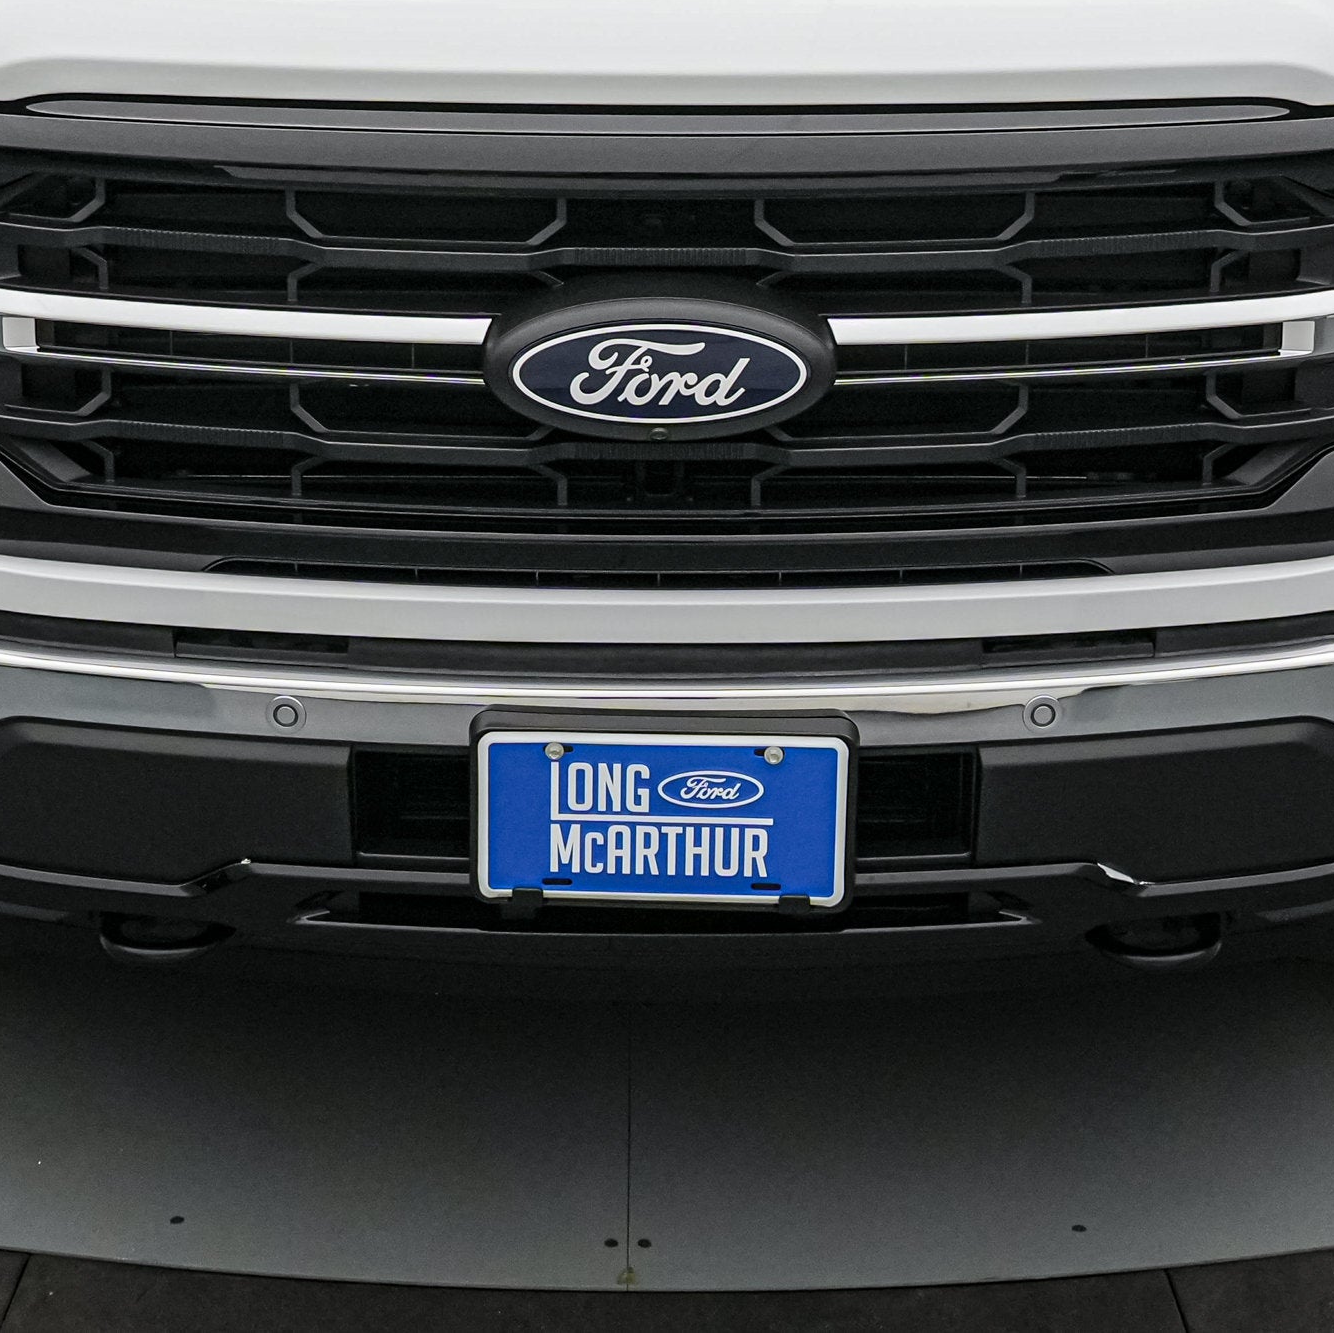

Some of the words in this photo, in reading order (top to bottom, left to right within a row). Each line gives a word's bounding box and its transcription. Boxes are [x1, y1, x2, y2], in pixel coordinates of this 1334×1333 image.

[570, 338, 750, 406] Ford
[551, 762, 650, 818] LONG
[680, 776, 742, 800] Ford
[550, 823, 768, 877] McARTHUR
